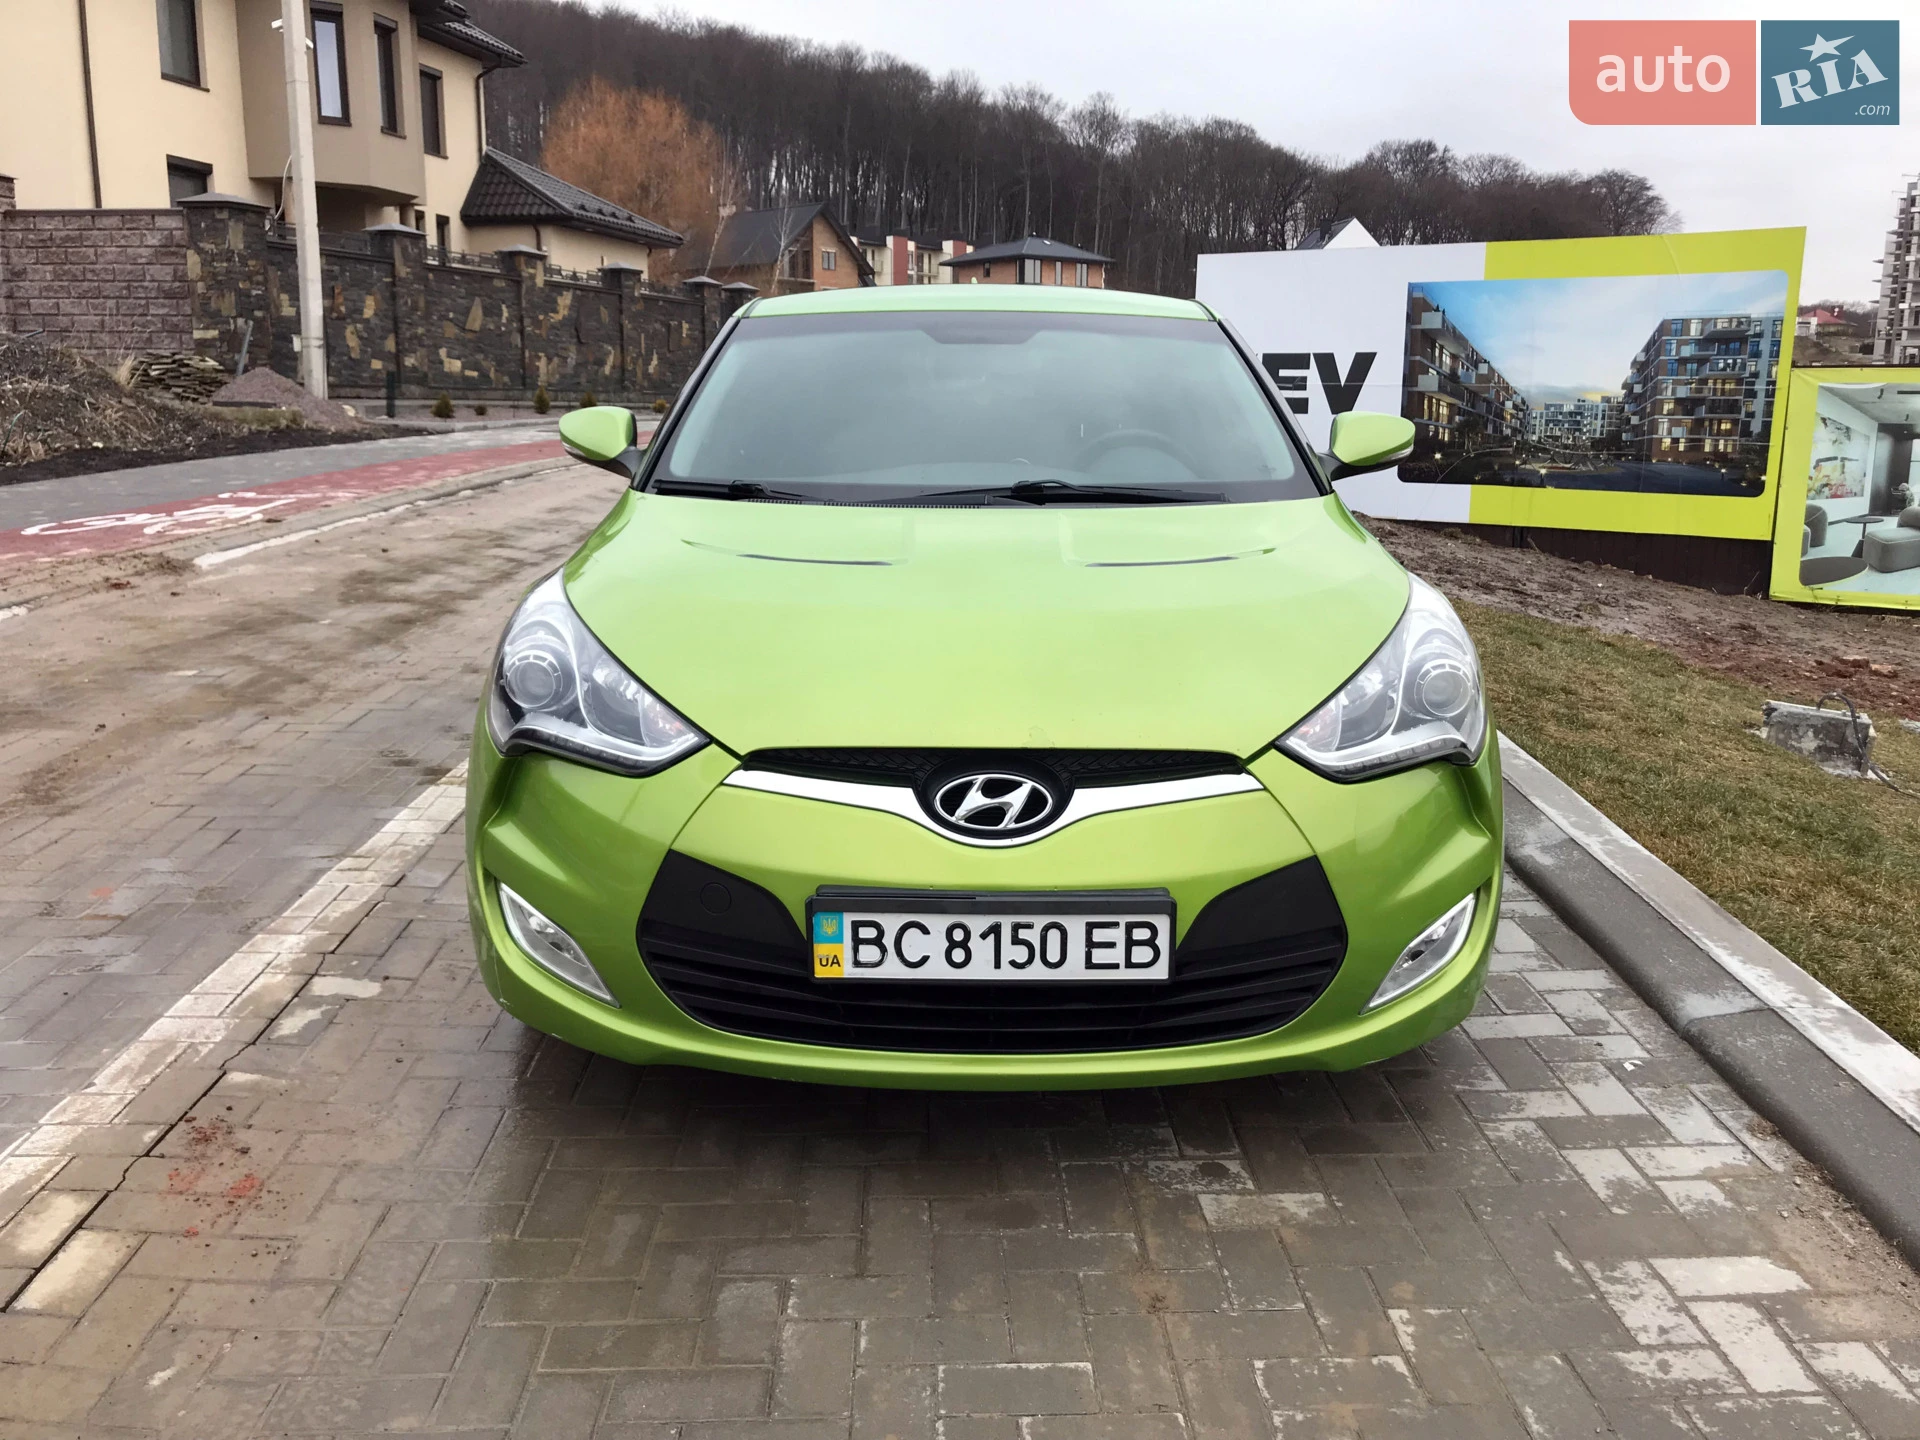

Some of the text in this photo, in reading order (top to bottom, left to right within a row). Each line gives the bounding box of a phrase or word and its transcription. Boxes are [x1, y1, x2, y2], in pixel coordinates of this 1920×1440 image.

[1256, 352, 1377, 415] EV
[819, 954, 841, 968] UA
[851, 920, 1161, 970] BC 8150 EB
